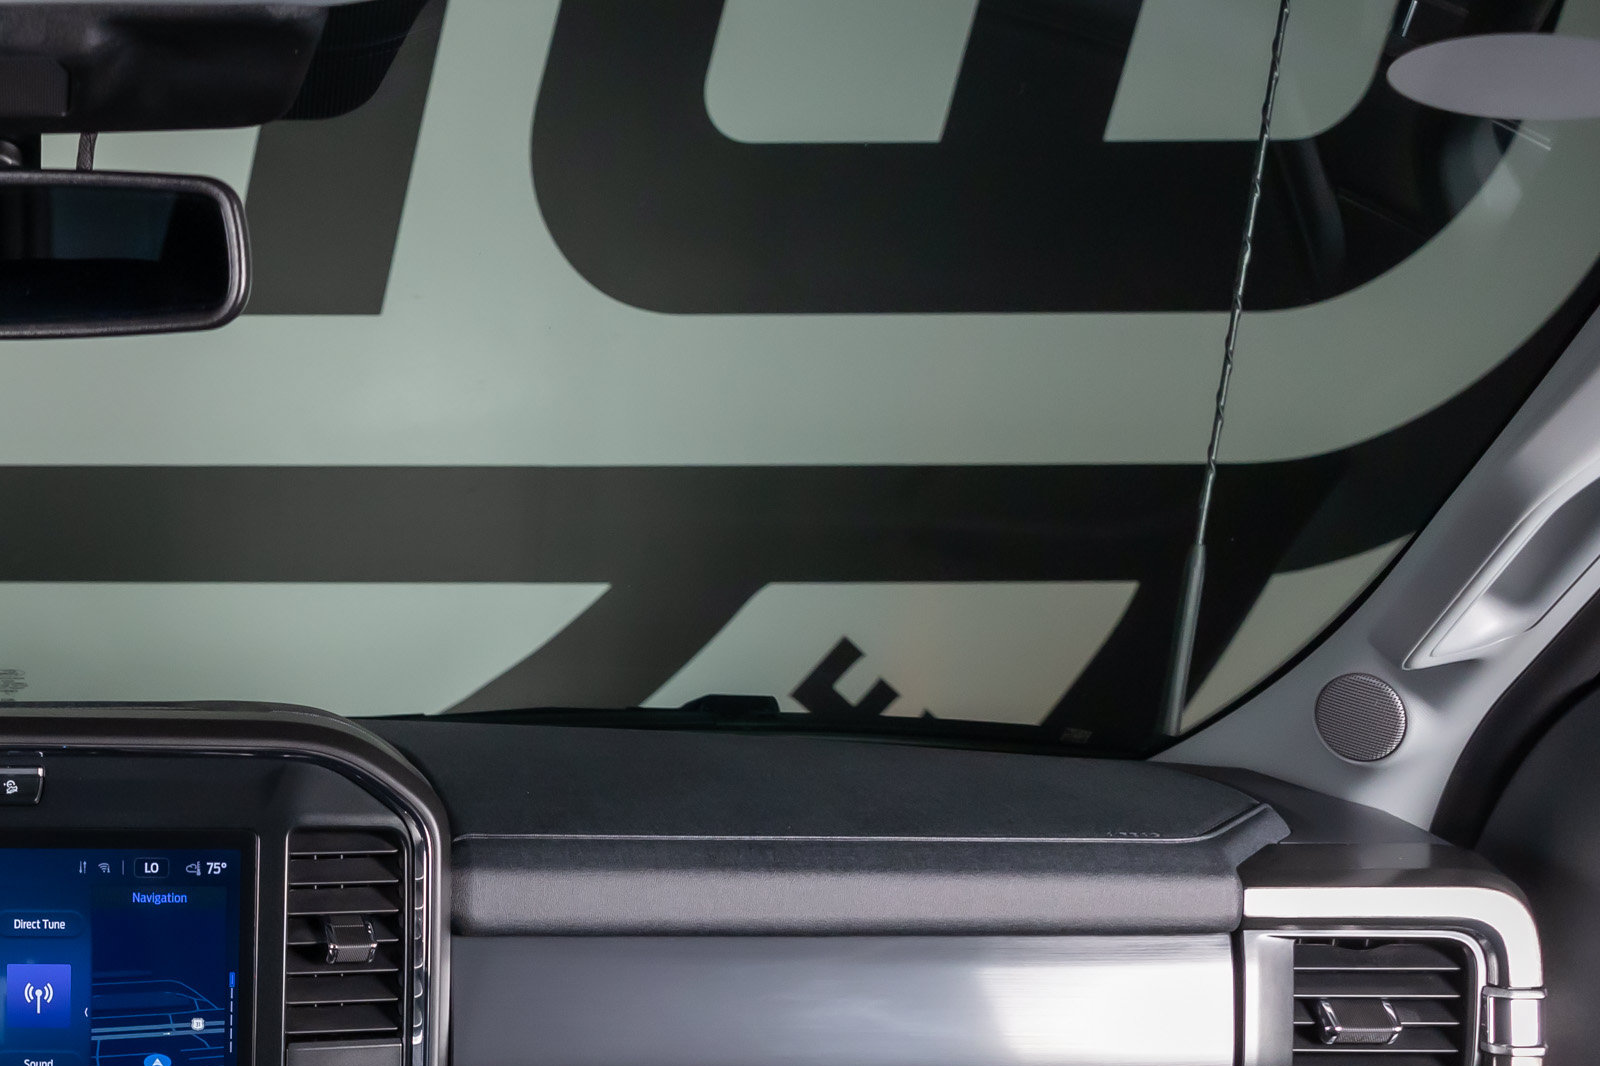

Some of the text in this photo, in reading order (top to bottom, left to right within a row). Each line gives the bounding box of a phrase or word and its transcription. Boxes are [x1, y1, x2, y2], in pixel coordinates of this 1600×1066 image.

[144, 862, 159, 874] LO
[206, 862, 228, 875] 75°
[132, 892, 188, 905] Navigation
[13, 918, 66, 930] Direct Tune
